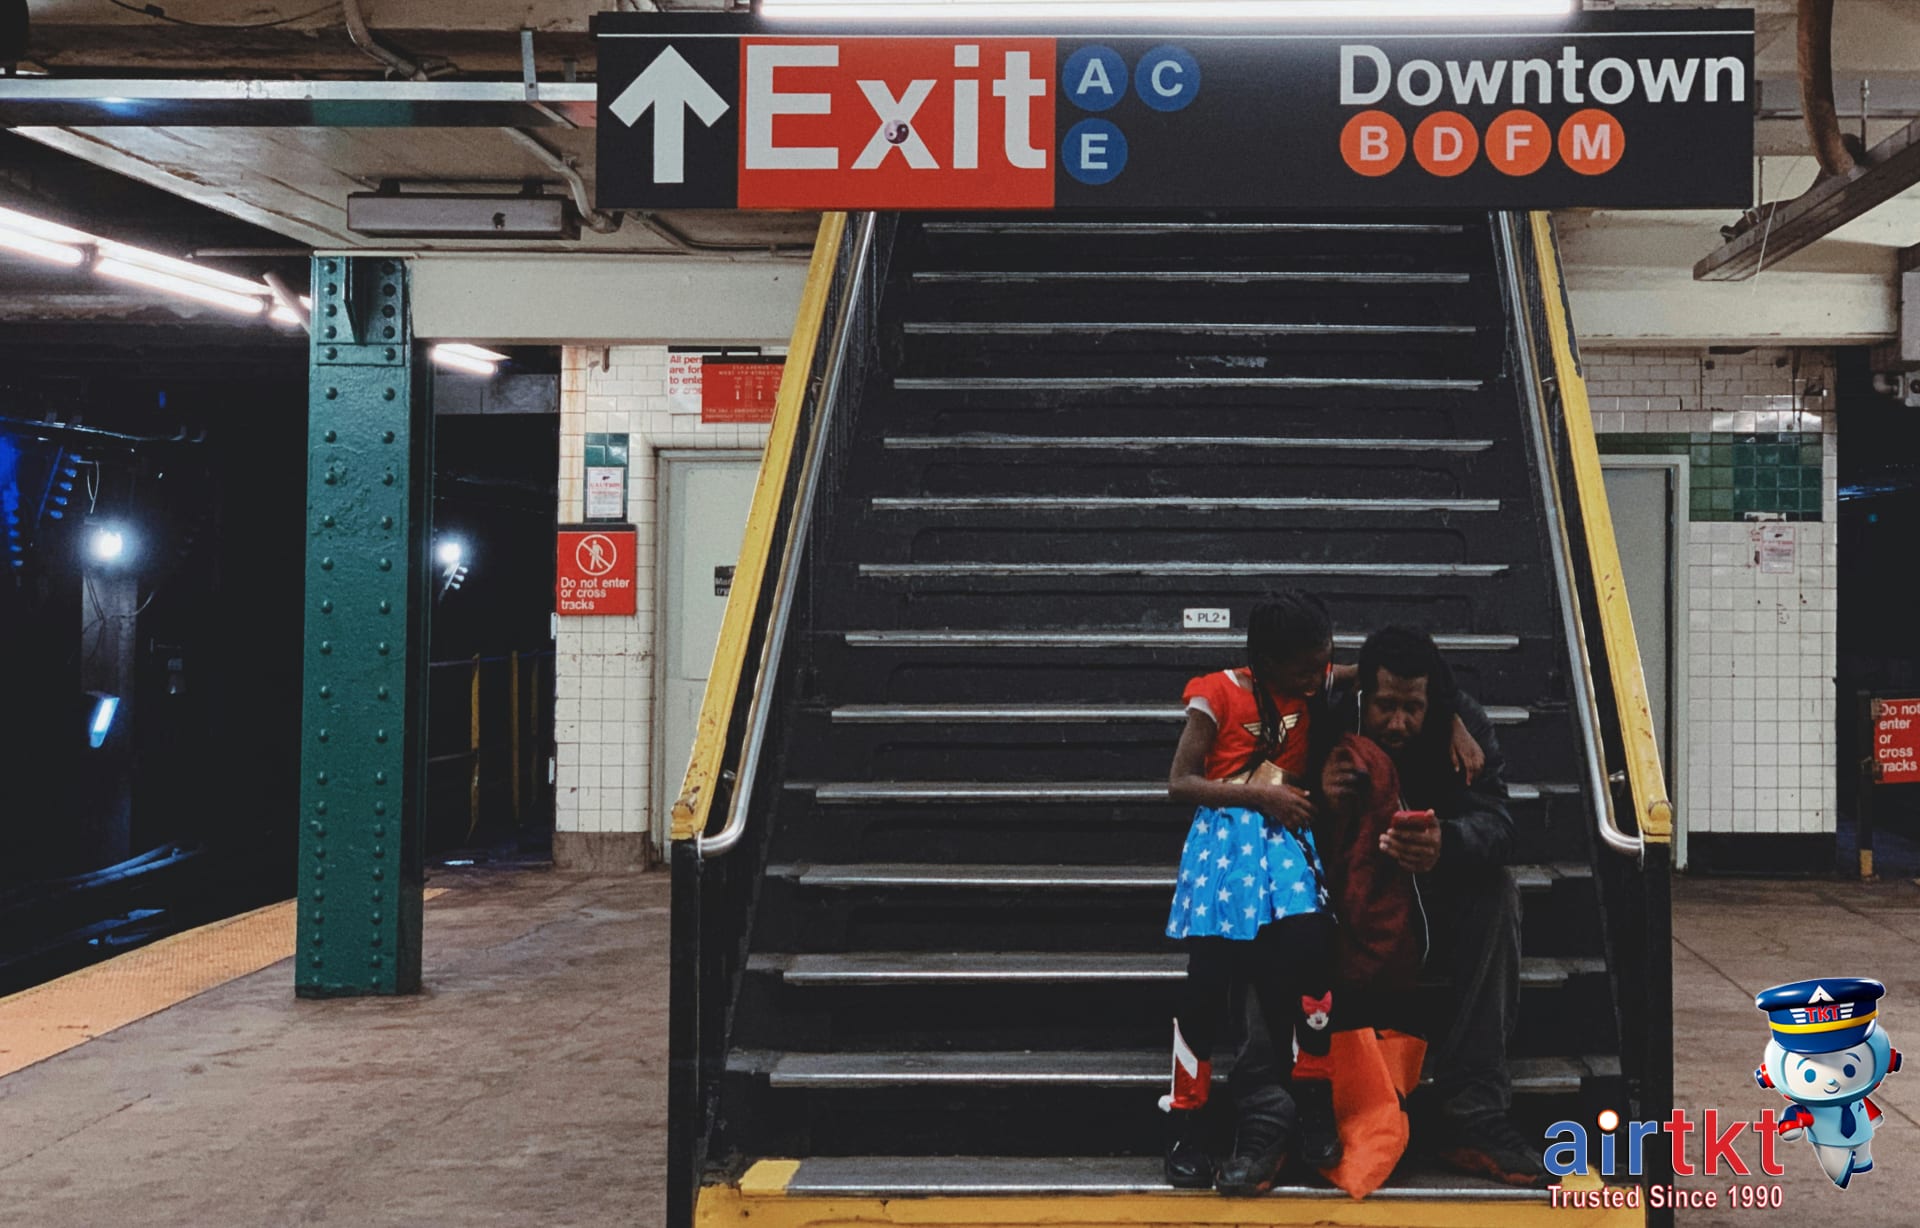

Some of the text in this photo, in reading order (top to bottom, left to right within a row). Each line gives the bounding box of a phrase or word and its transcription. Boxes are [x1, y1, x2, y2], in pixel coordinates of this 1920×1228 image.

[1076, 58, 1183, 96] A C
[1340, 45, 1745, 106] Downtown
[746, 45, 1046, 169] Exit
[1360, 124, 1611, 161] B D F M
[1080, 133, 1108, 169] E
[670, 355, 682, 364] All
[669, 364, 702, 374] are for
[669, 376, 680, 385] to
[560, 577, 630, 588] Do not enter
[560, 589, 607, 598] or cross
[561, 599, 595, 610] tracks
[1197, 612, 1220, 623] PL2
[1879, 717, 1912, 730] enter
[1879, 734, 1892, 744] or
[1879, 747, 1913, 758] cross
[1881, 759, 1918, 772] racks
